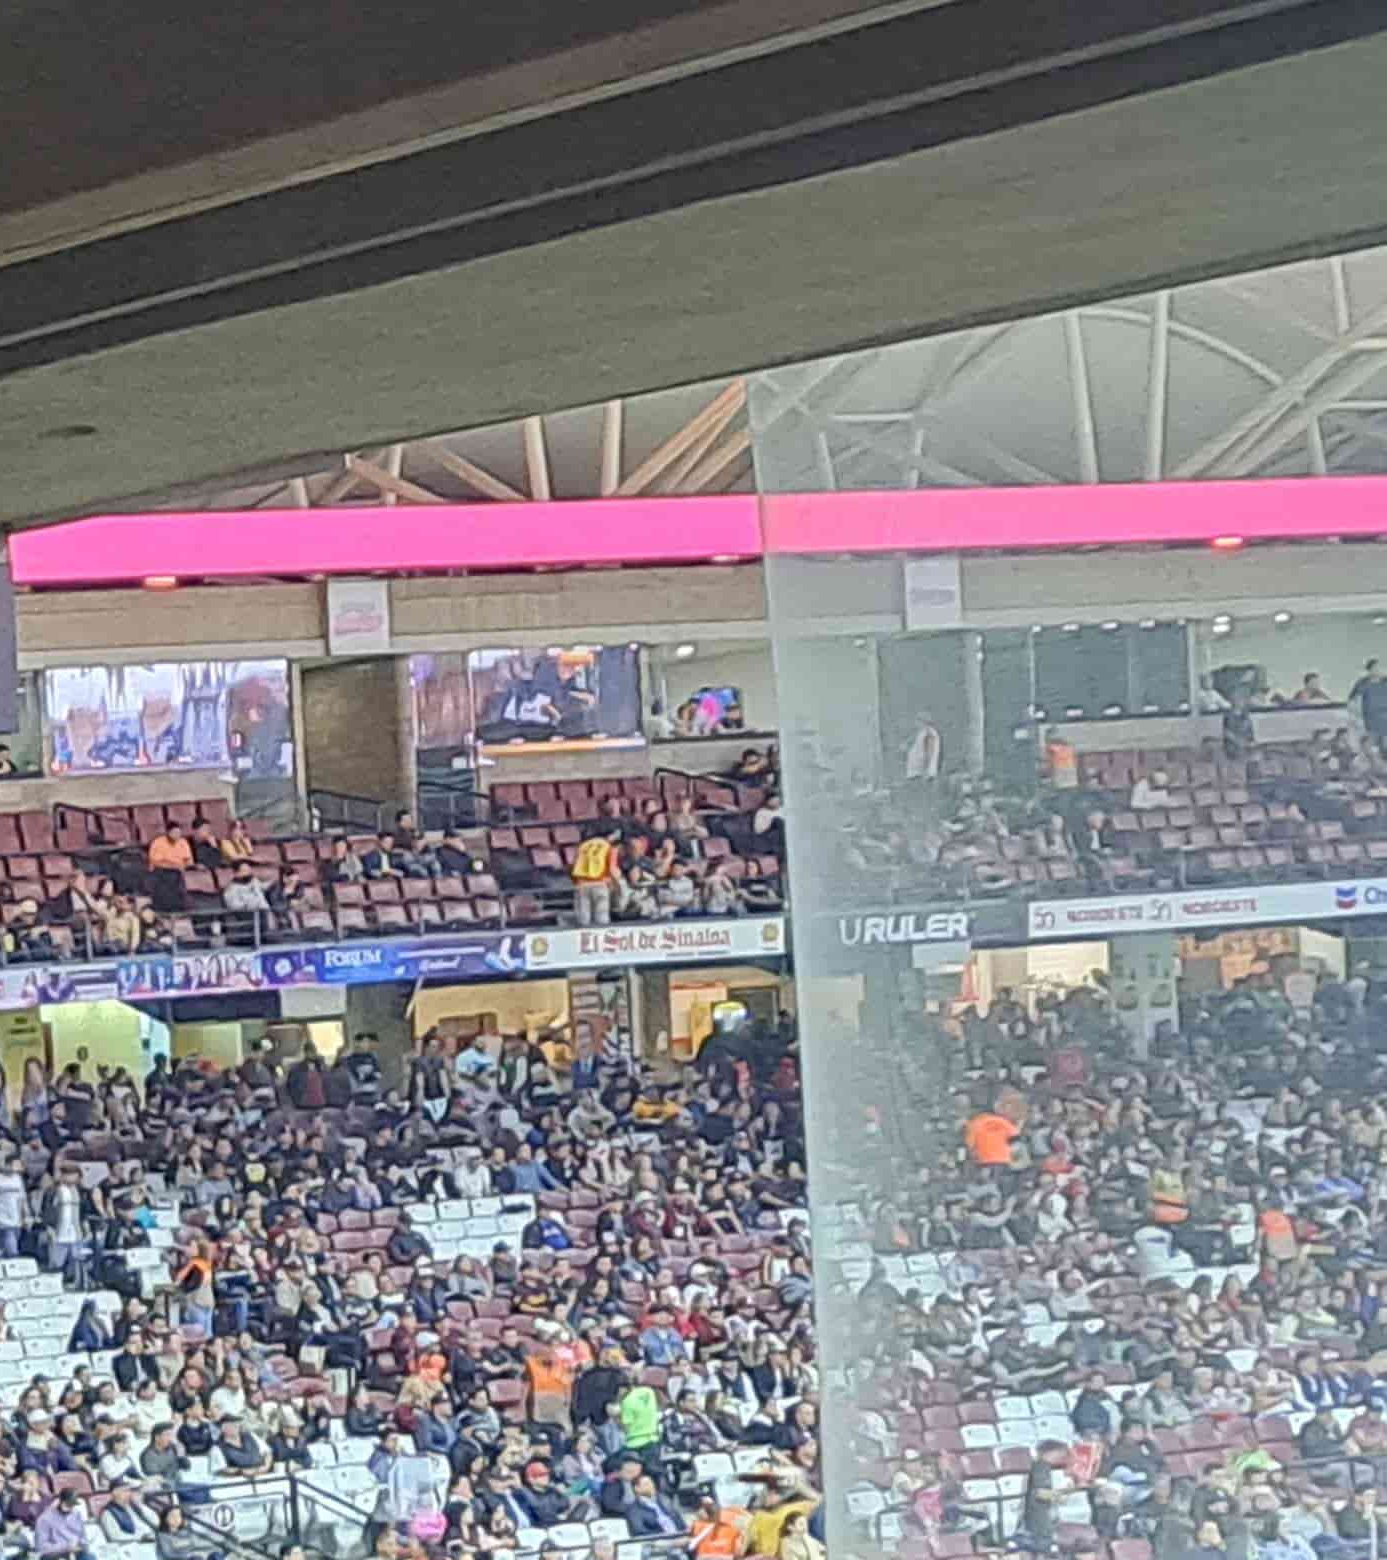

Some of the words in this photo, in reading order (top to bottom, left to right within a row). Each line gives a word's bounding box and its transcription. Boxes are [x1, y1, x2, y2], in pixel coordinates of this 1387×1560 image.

[579, 932, 599, 954] El
[604, 929, 634, 953] Sol
[638, 931, 657, 949] de
[661, 928, 731, 949] Sinaloa
